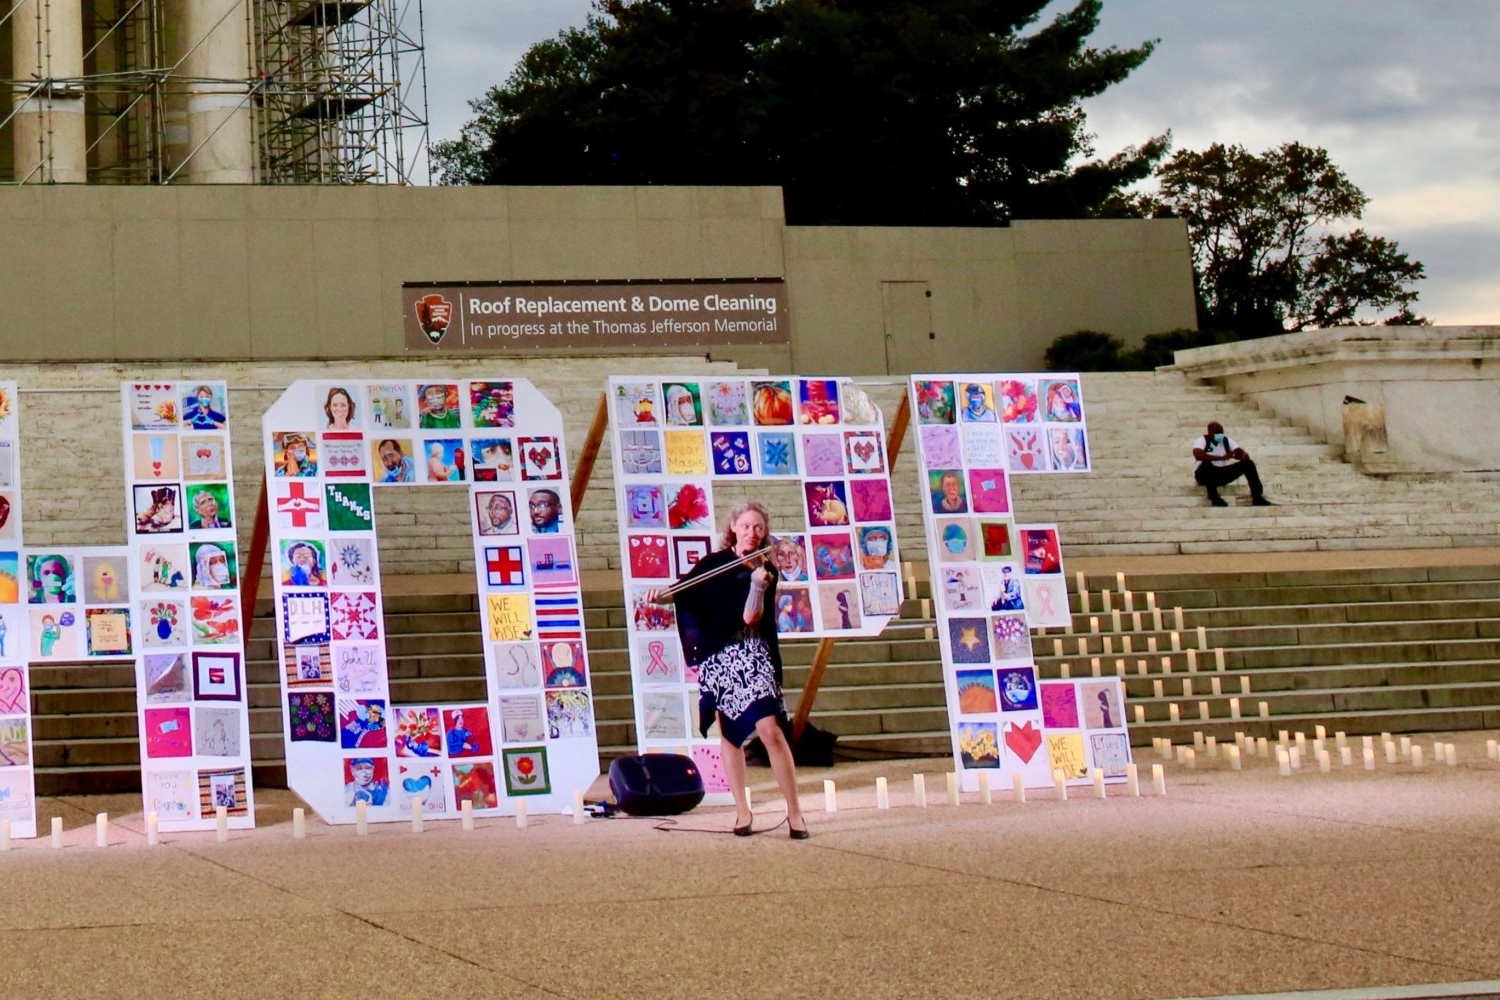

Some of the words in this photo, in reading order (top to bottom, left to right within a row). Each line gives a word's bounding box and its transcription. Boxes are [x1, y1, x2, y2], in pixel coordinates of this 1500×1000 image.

[469, 297, 511, 314] Roof
[515, 296, 627, 317] Replacement
[631, 296, 644, 312] &
[649, 295, 700, 312] Dome
[704, 294, 777, 315] Cleaning
[471, 322, 483, 336] In
[487, 323, 545, 339] progress
[549, 322, 563, 335] at
[567, 320, 589, 334] the
[592, 319, 647, 334] Thomas
[650, 318, 710, 333] Jefferson
[714, 317, 777, 332] Memorial
[327, 485, 371, 521] THANKS
[490, 597, 510, 611] WE
[492, 611, 525, 626] WILL
[1049, 737, 1068, 751] WE
[1052, 750, 1077, 765] WILL
